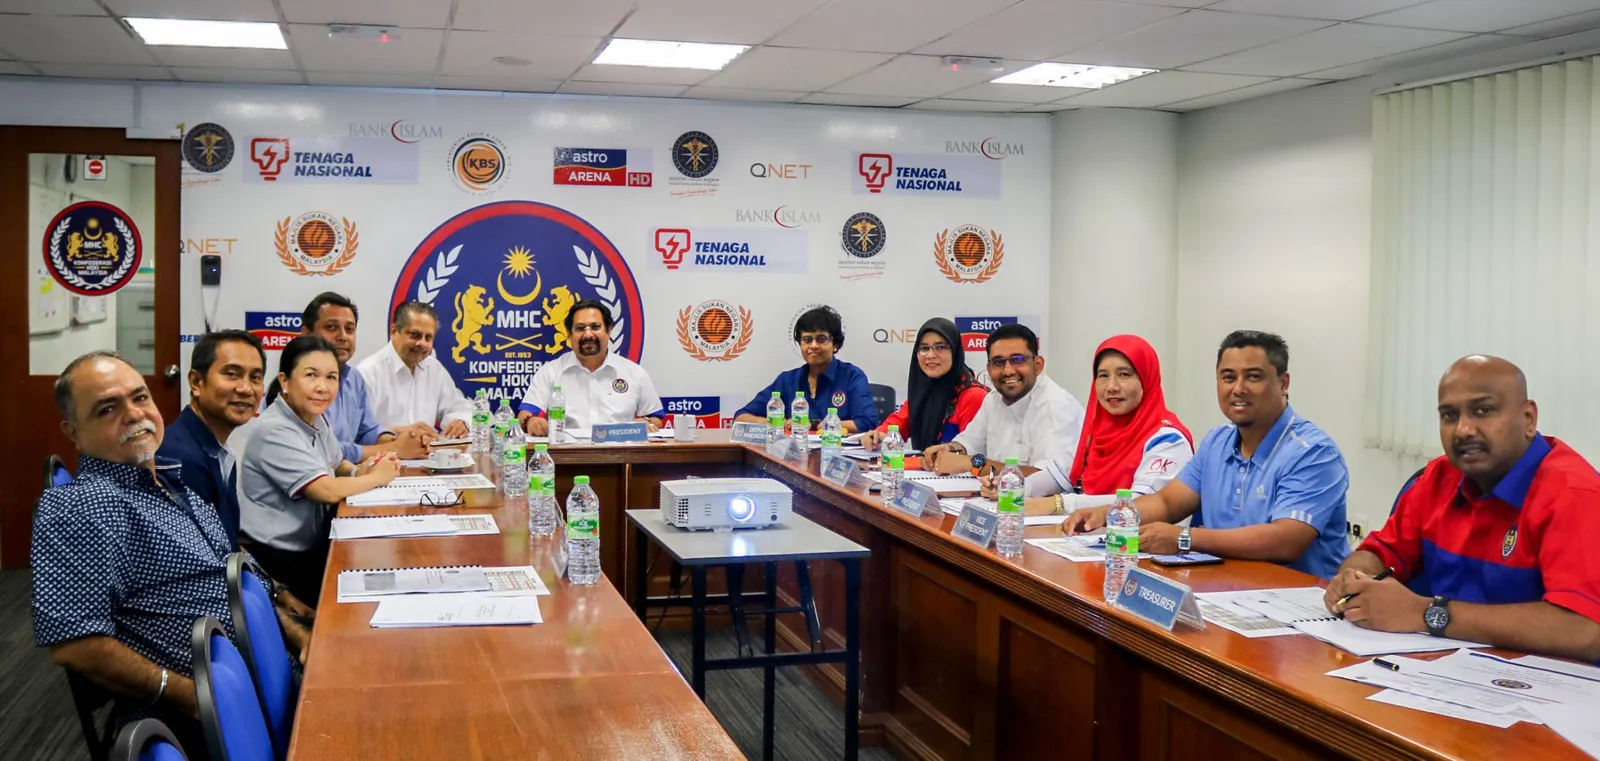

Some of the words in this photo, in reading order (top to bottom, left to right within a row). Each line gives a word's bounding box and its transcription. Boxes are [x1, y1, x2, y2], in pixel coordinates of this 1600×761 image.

[350, 124, 390, 138] BANK
[400, 124, 443, 138] ISLAM
[946, 141, 981, 154] BANK
[988, 142, 1024, 155] ISLAM
[294, 152, 354, 164] TENAGA
[572, 151, 608, 163] astro
[470, 158, 496, 170] KBS
[750, 162, 813, 179] QNET
[294, 166, 372, 178] NASIONAL
[568, 172, 612, 182] ARENA
[630, 174, 650, 184] HD
[896, 166, 947, 179] TENAGA
[896, 179, 962, 192] NASIONAL
[736, 210, 774, 222] BANK
[782, 210, 821, 224] ISLAM
[302, 213, 327, 222] SUKAN
[328, 218, 342, 245] NEGARA
[695, 242, 750, 253] TENAGA
[978, 230, 990, 255] NEGARA
[300, 255, 333, 264] MALAYSIA
[695, 254, 766, 266] NASIONAL
[956, 264, 983, 272] MALAYSIA
[265, 314, 302, 328] astro
[497, 310, 541, 328] MHC
[692, 310, 702, 332] MAJLIS
[702, 302, 724, 310] SUKAN
[726, 306, 738, 332] NEGARA
[971, 319, 1002, 330] astro
[873, 328, 918, 343] QNE
[700, 341, 730, 350] MALAYSIA
[968, 338, 988, 348] ARE
[469, 361, 546, 374] KONFEDER
[668, 399, 702, 411] astro
[608, 428, 642, 436] PRESIDENT
[1150, 458, 1174, 472] OK
[1138, 586, 1176, 612] TREASURER
